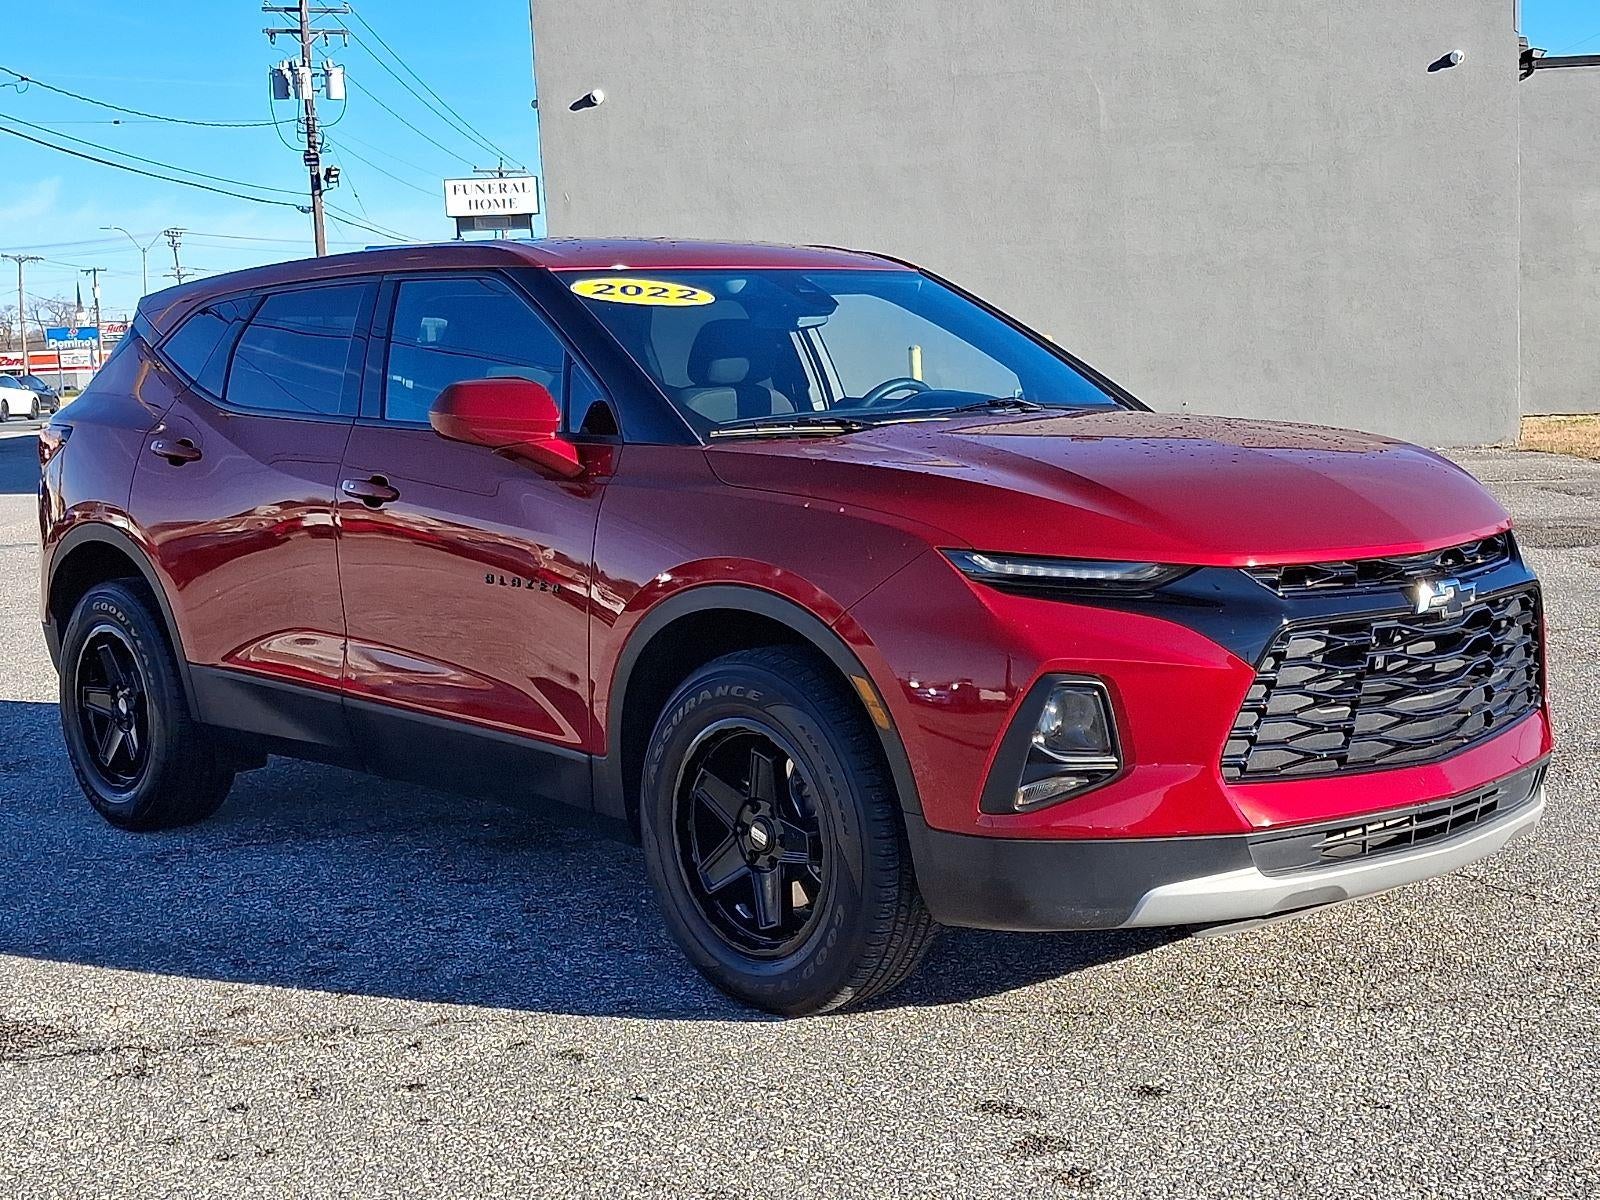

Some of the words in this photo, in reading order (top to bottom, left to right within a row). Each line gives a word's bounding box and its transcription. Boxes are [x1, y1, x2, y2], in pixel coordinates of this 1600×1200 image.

[453, 182, 530, 195] FUNERAL
[468, 198, 518, 210] HOME
[592, 283, 698, 301] 2022
[48, 337, 98, 349] Domino's
[485, 573, 561, 594] BLAZER
[648, 684, 765, 785] ASSURANCE
